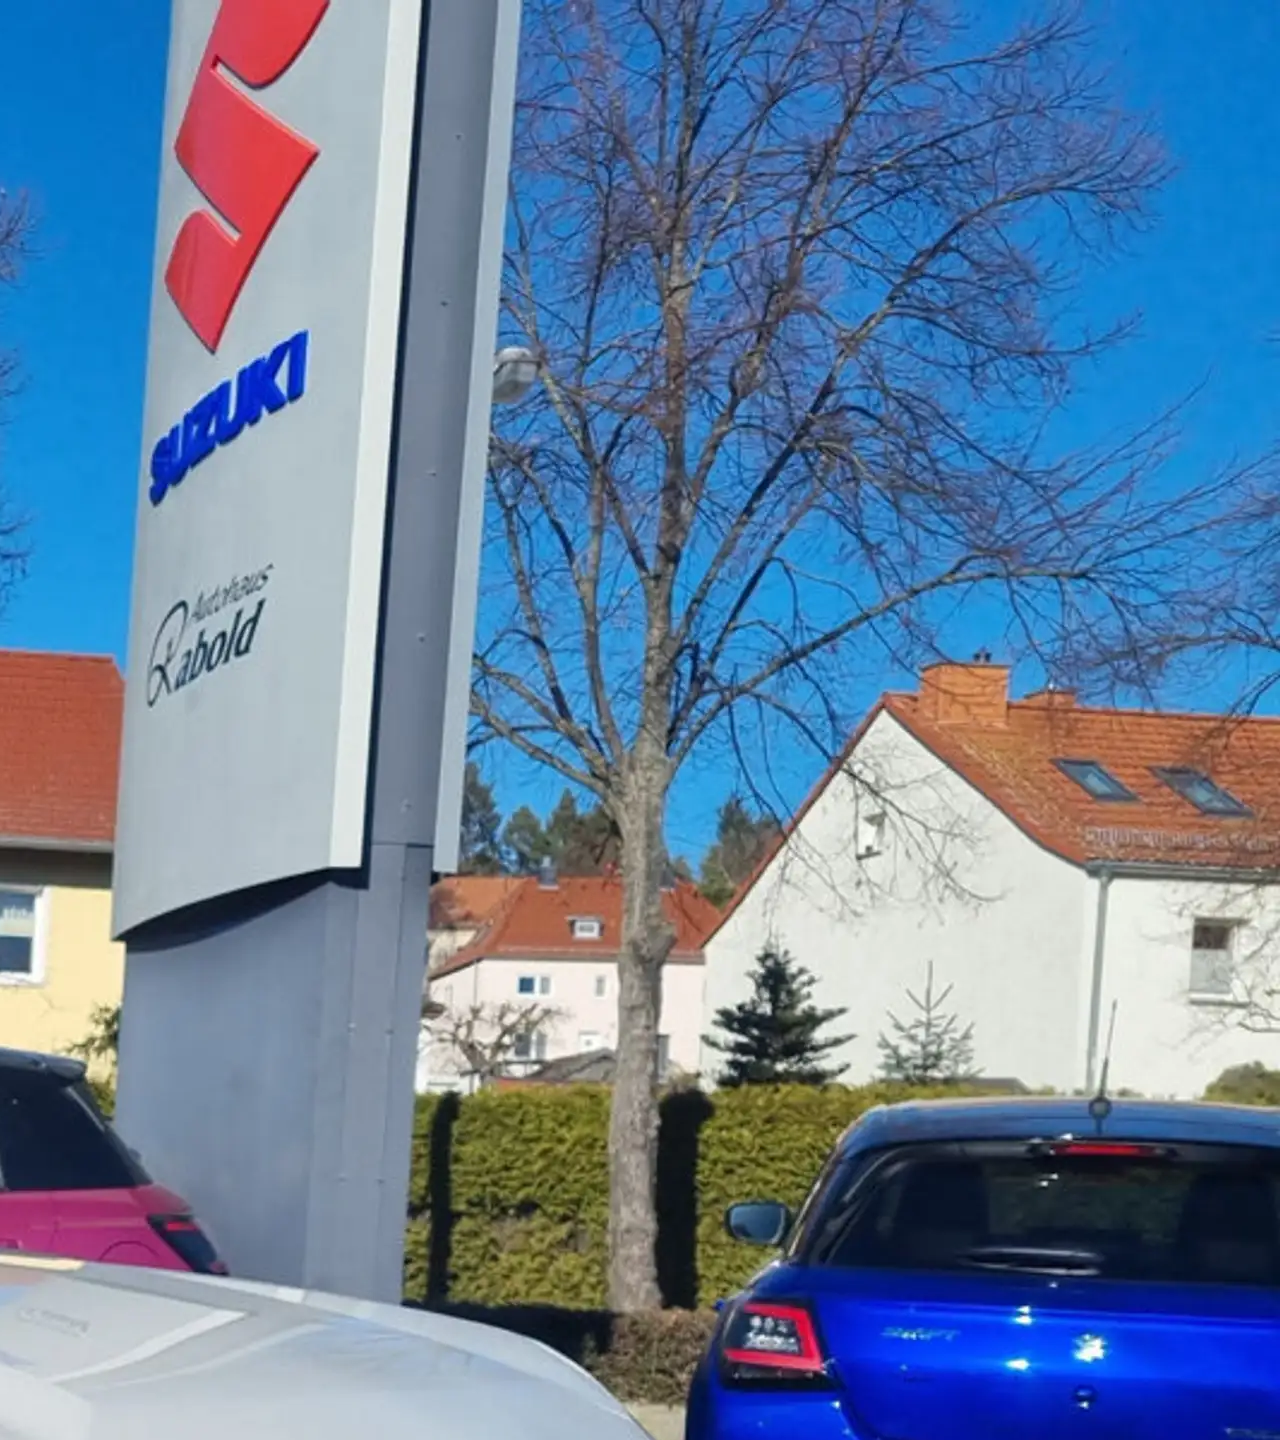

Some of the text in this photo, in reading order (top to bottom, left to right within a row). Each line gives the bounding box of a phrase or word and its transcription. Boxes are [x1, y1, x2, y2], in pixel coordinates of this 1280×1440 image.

[149, 330, 308, 507] SUZUKI
[191, 563, 274, 625] Autohaus
[146, 598, 266, 708] Rabold
